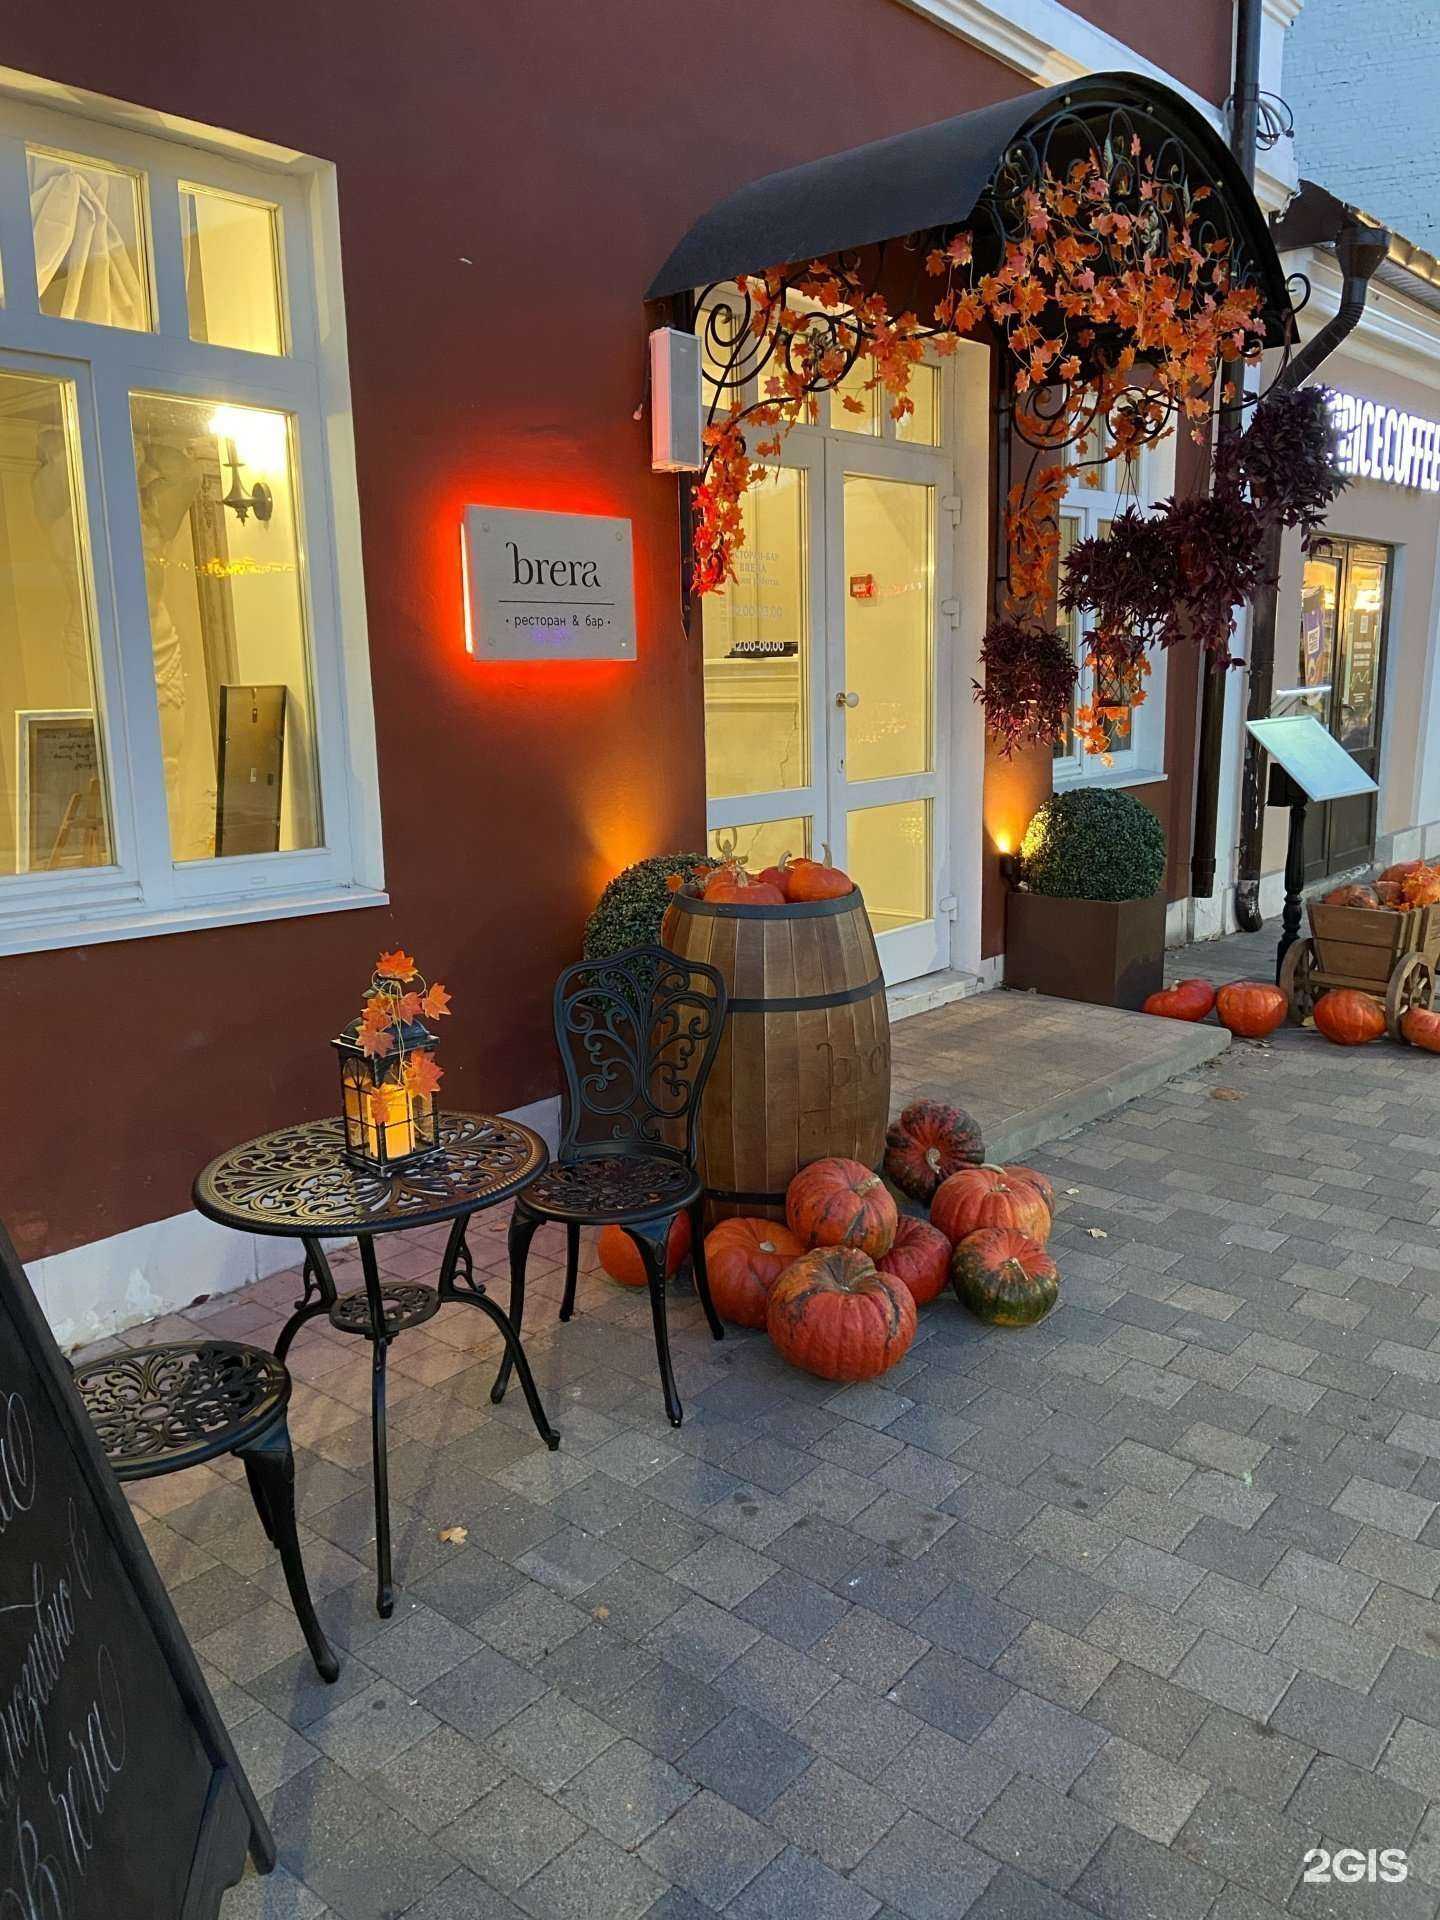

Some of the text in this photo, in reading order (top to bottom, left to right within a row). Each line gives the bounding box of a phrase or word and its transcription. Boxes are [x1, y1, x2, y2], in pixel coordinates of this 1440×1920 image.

[505, 541, 602, 587] brera
[514, 614, 605, 628] ресторан & бар
